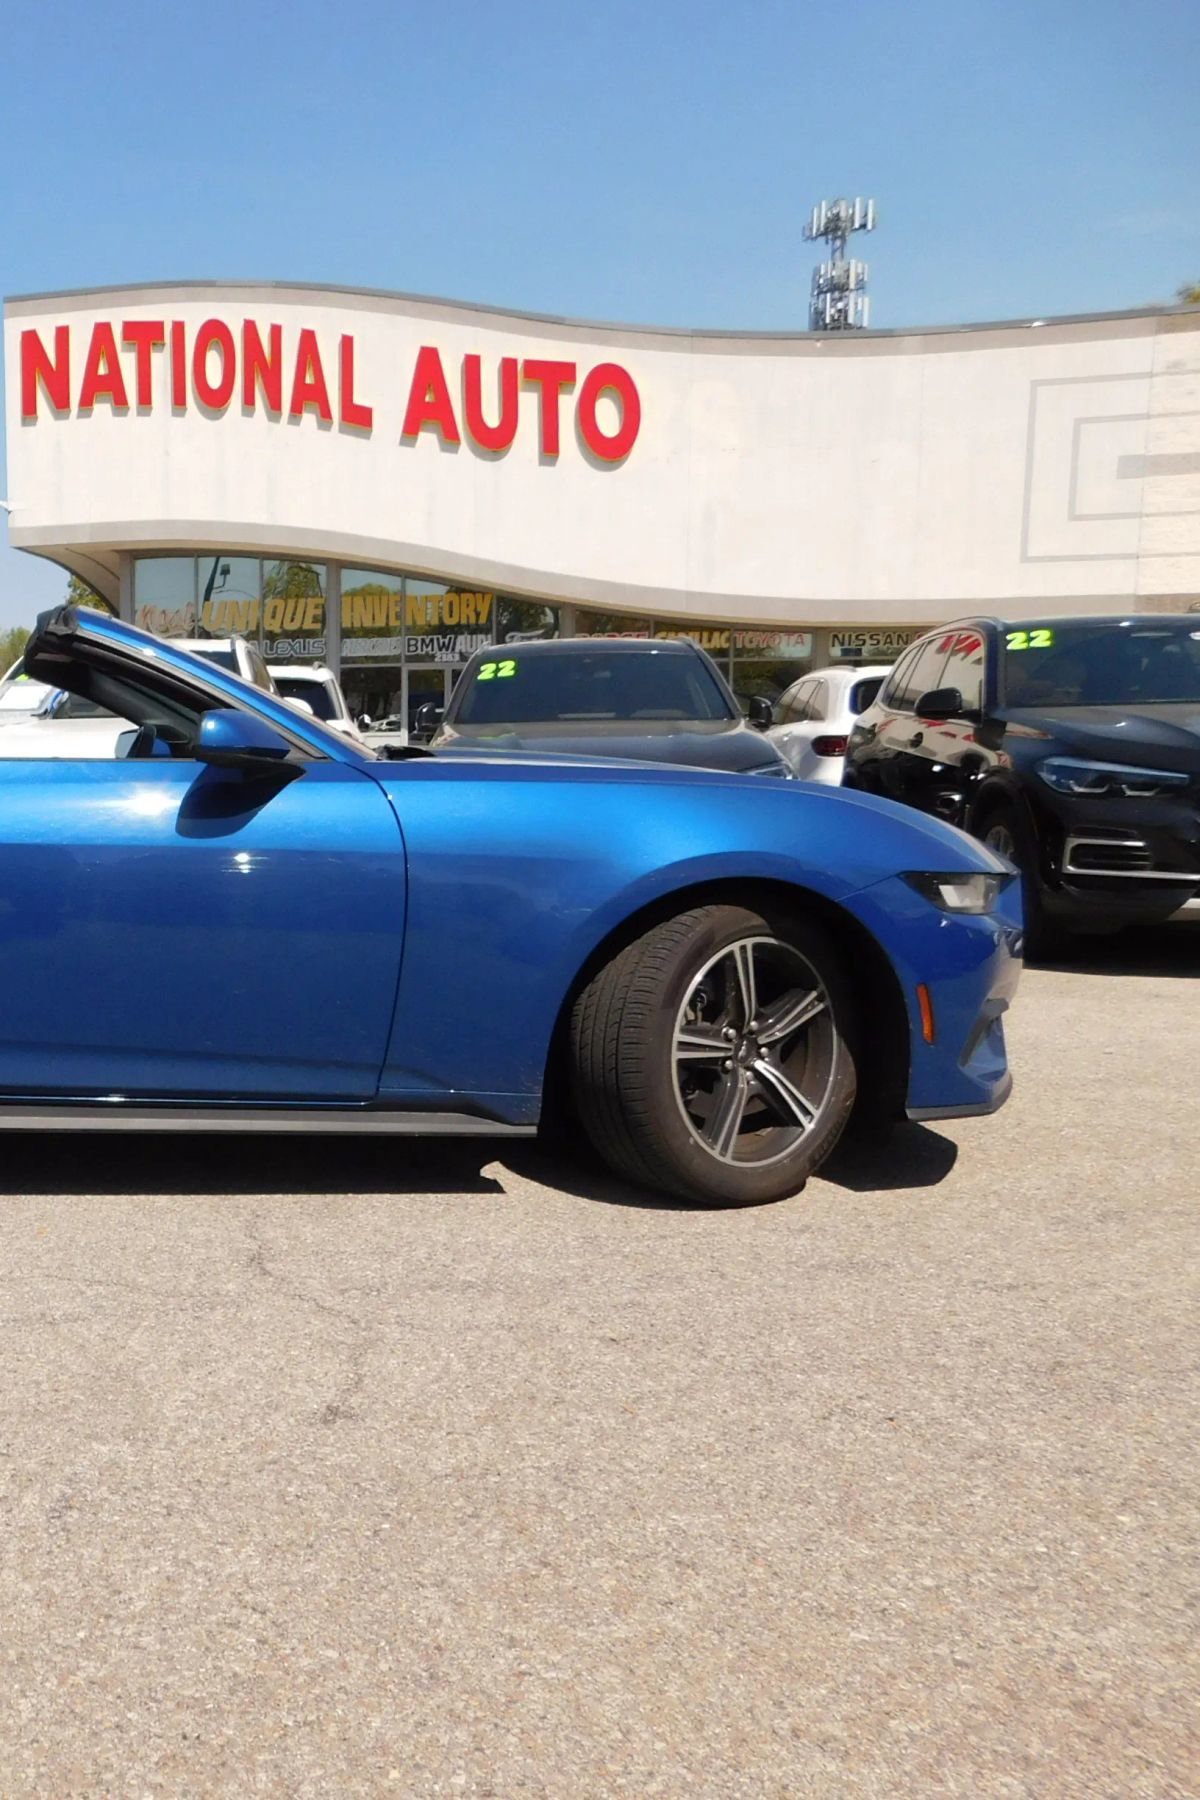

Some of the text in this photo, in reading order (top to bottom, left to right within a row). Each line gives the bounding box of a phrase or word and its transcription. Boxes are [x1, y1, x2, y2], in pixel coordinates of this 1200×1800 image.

[21, 318, 641, 461] NATIONAL AUTO
[202, 597, 326, 633] UNIQUE
[341, 592, 493, 627] INVENTORY
[263, 639, 326, 658] LEXUS
[406, 635, 455, 655] BMW
[655, 631, 730, 648] LLAC
[735, 631, 805, 648] TOYOTA
[831, 632, 909, 647] NISSAN
[1006, 630, 1051, 650] 22
[477, 659, 515, 680] 22
